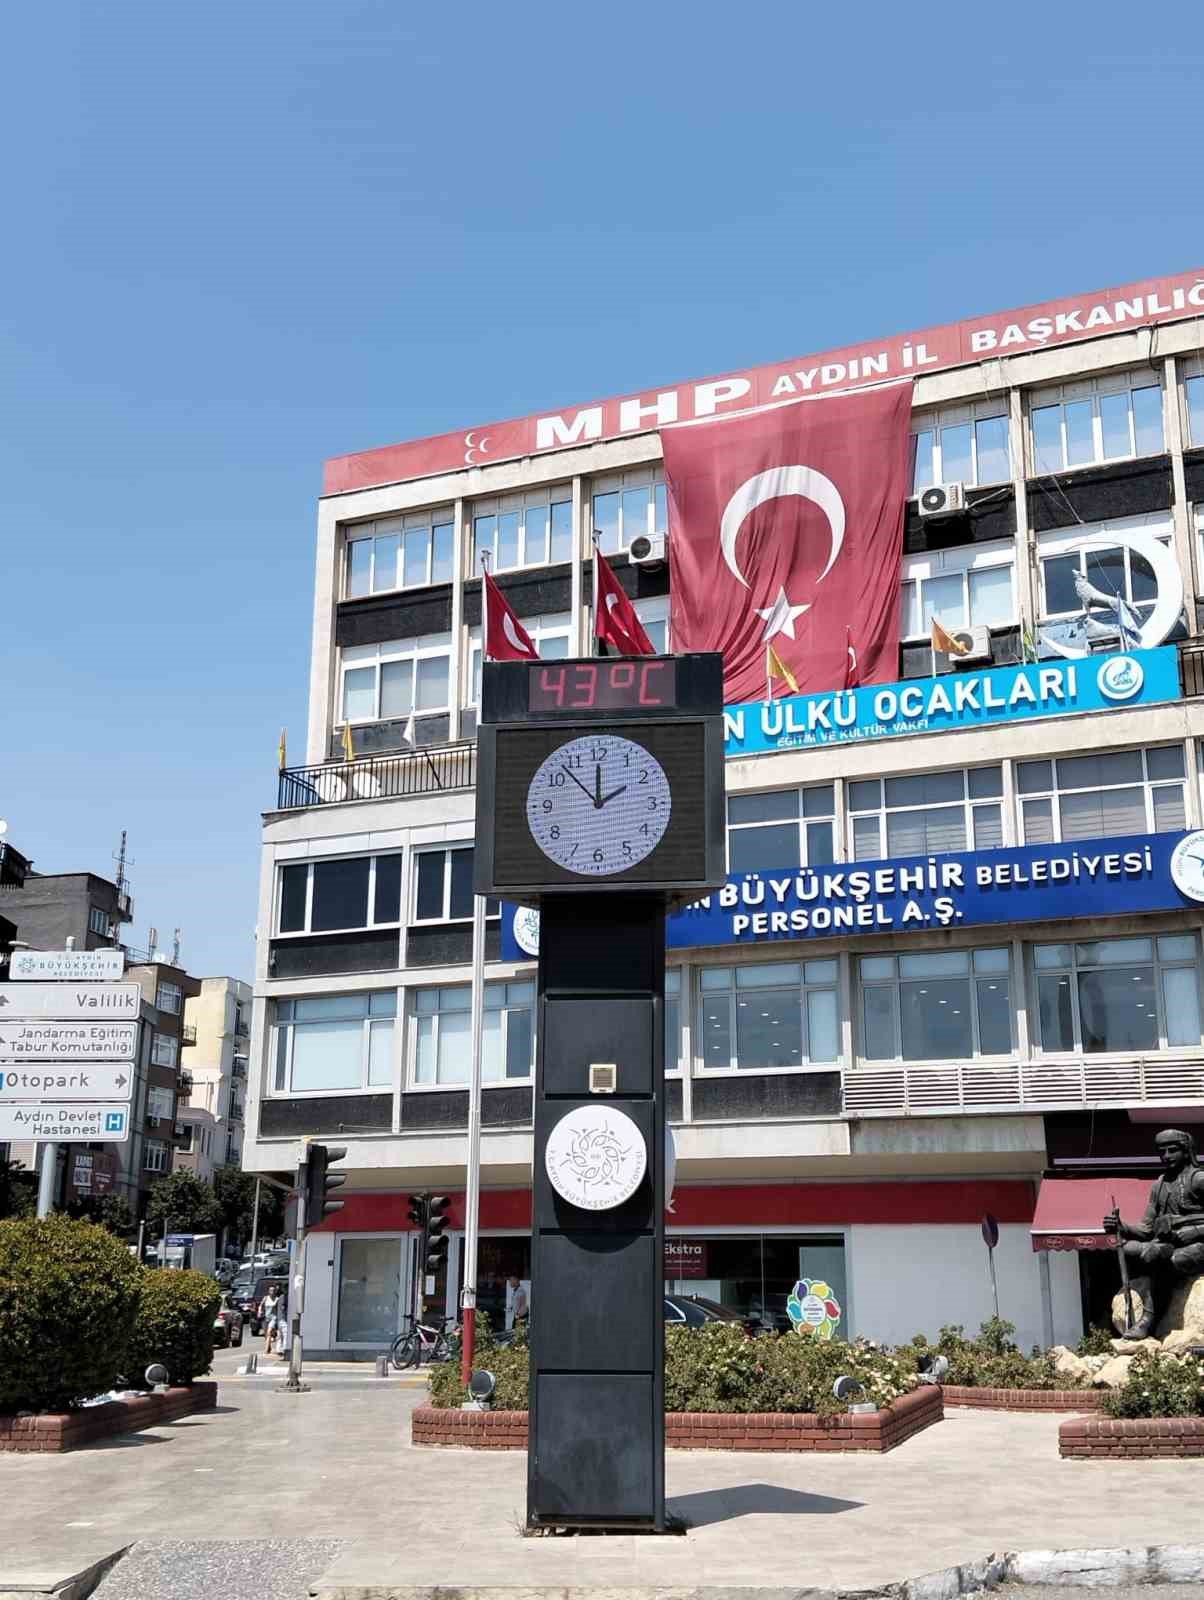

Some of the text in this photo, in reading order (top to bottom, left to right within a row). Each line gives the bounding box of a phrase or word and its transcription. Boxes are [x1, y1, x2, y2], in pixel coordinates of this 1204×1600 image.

[536, 378, 750, 450] MHP
[771, 352, 889, 397] AYDIN
[902, 341, 939, 368] İL
[760, 689, 857, 736] ÜLKÜ
[874, 665, 1077, 721] OCAKLARI
[819, 729, 838, 742] VE
[892, 719, 929, 733] VAKFI
[567, 755, 584, 769] 11
[590, 748, 607, 762] 12
[623, 755, 631, 768] 1
[548, 773, 566, 787] 10
[638, 769, 649, 784] 2
[542, 799, 553, 813] 9
[648, 796, 657, 811] 3
[550, 825, 561, 840] 8
[638, 823, 649, 836] 4
[570, 843, 580, 857] 7
[593, 848, 604, 862] 6
[621, 840, 632, 856] 5
[719, 857, 964, 907] BÜYÜKŞEHİR
[976, 845, 1152, 886] BELEDİYESİ
[733, 897, 963, 936] PERSONEL A.Ş.
[76, 993, 135, 1008] Valilik
[18, 1027, 132, 1041] Jandarma Eğitim
[10, 1041, 132, 1054] Tabur Komutanlığı
[6, 1072, 89, 1091] Otopark
[14, 1110, 101, 1125] Aydın Devlet
[32, 1123, 101, 1135] Hastanesi
